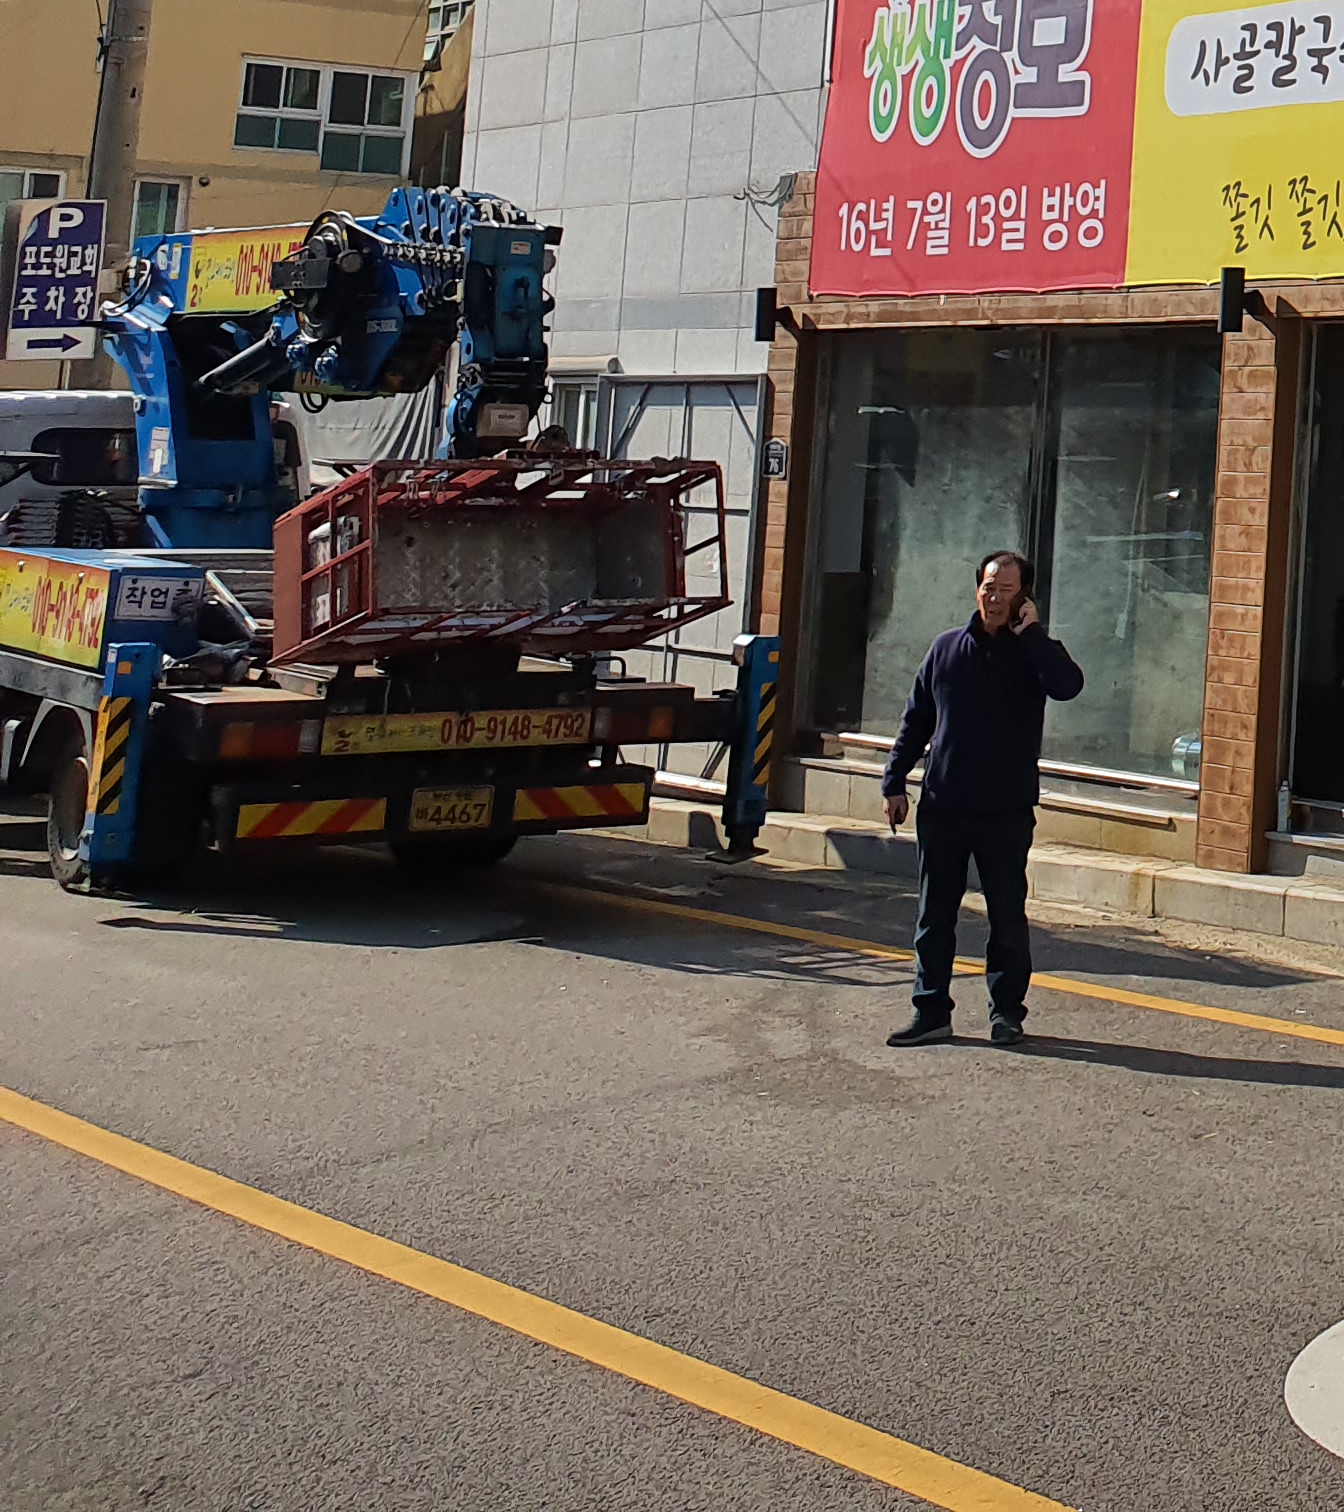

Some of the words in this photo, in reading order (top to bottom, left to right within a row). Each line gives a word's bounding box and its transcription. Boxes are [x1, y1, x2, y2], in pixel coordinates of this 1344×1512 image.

[47, 206, 85, 239] P
[838, 194, 895, 257] 16년
[906, 190, 952, 256] 7월
[965, 185, 1027, 251] 13일
[1041, 178, 1107, 252] 방영
[1221, 179, 1276, 254] 쫄깃
[20, 244, 99, 279] 포도원교회
